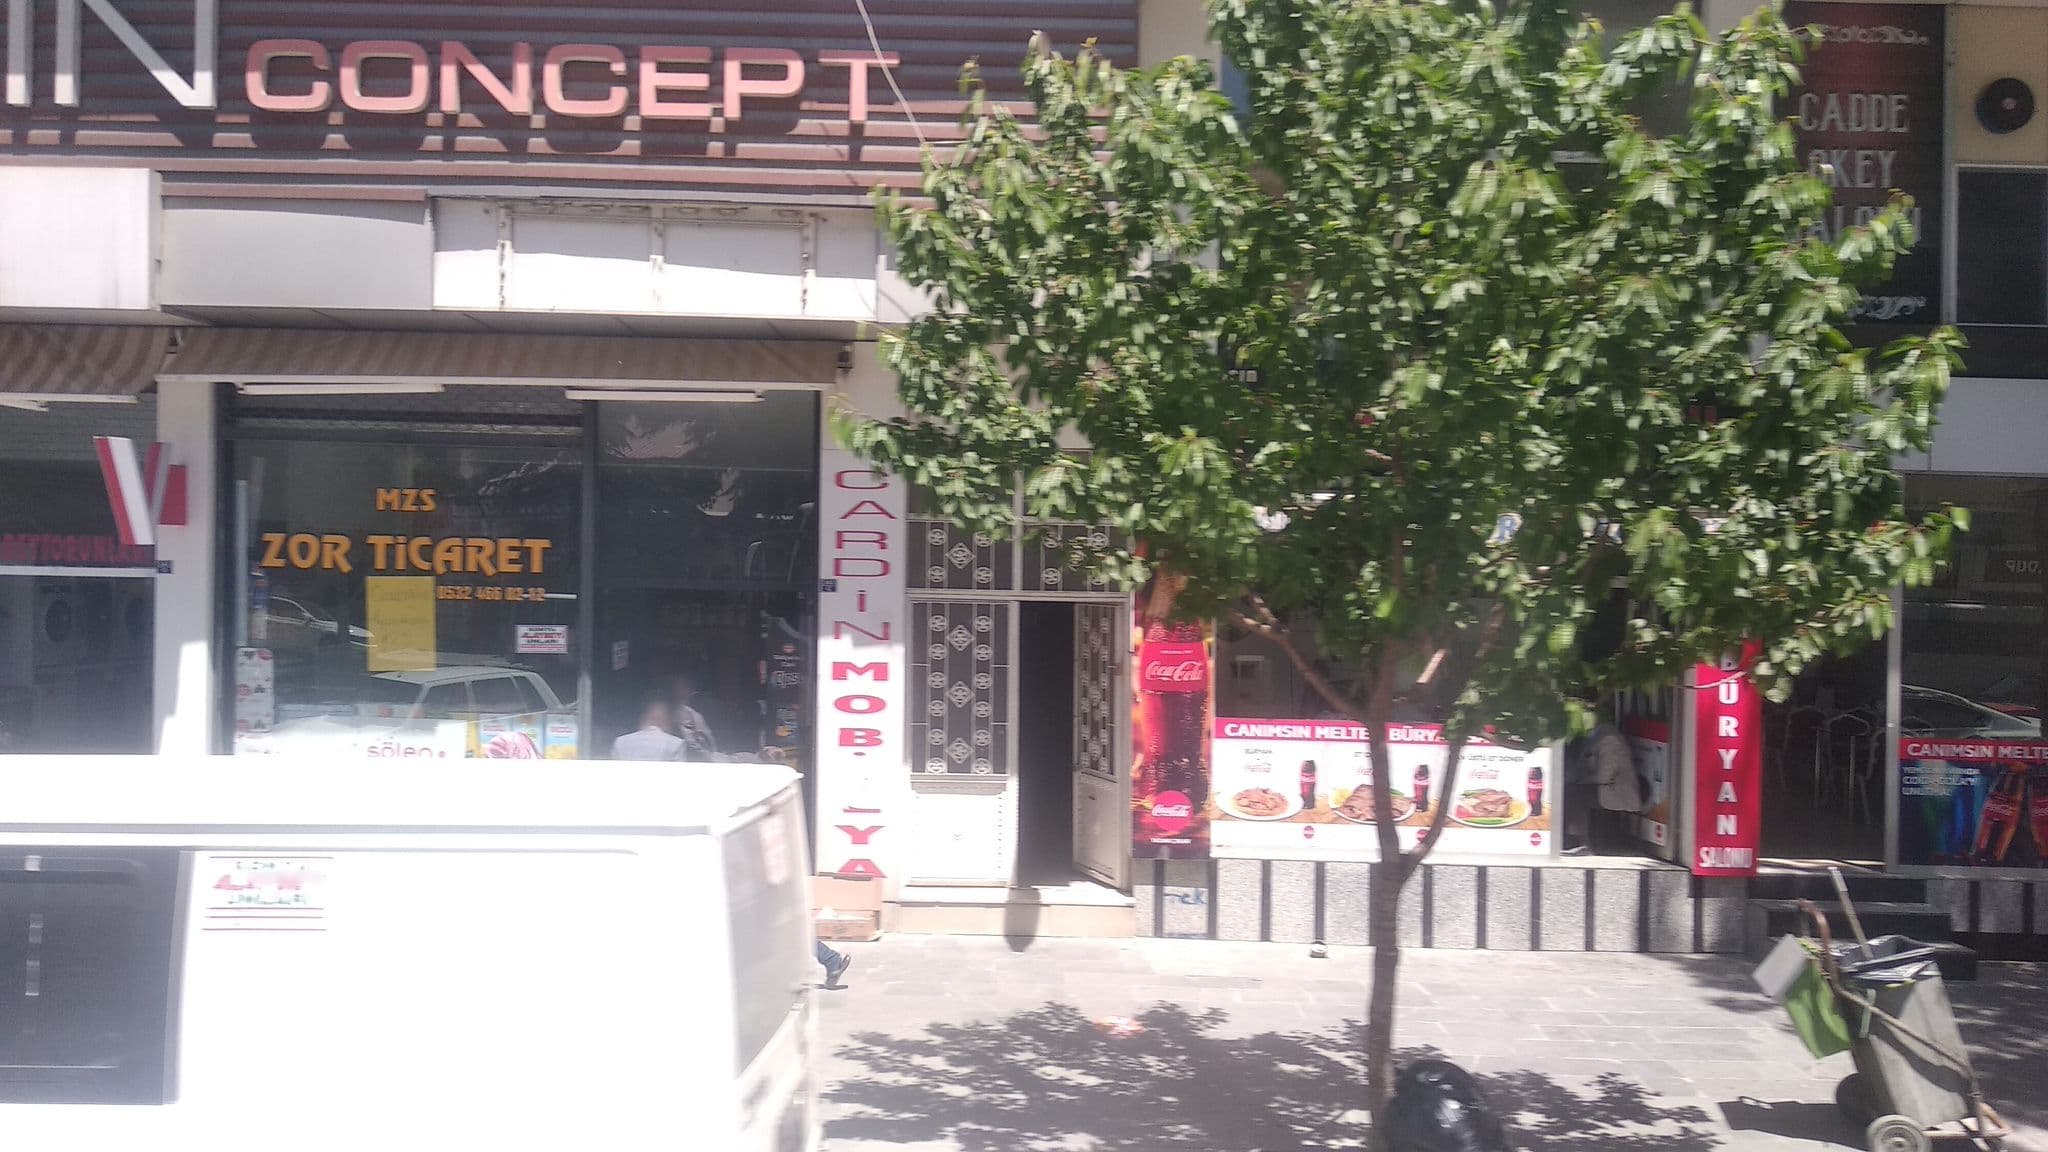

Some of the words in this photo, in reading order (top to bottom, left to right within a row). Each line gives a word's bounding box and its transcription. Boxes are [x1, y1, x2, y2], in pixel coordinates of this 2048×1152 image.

[245, 39, 900, 123] CONCEPT
[1799, 92, 1910, 133] CADDE
[375, 488, 438, 512] MZS
[260, 533, 352, 574] ZOR
[1315, 725, 1371, 742] MELTE
